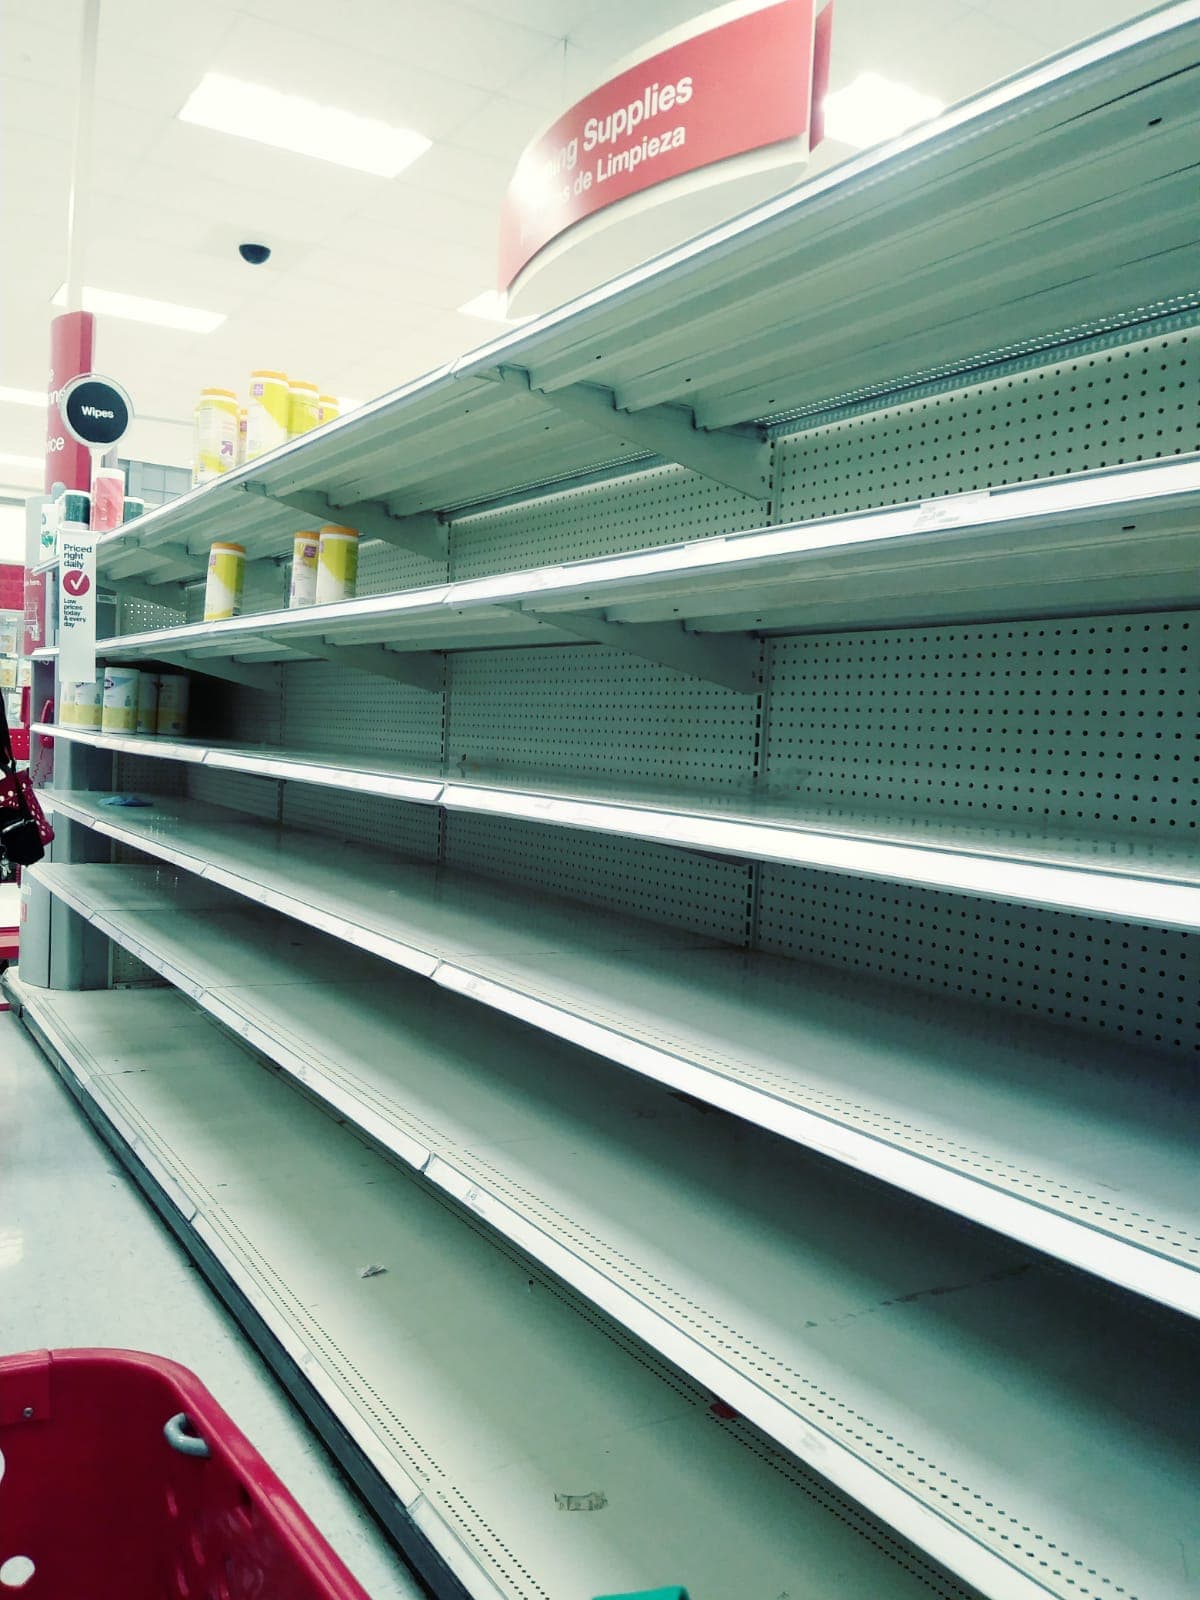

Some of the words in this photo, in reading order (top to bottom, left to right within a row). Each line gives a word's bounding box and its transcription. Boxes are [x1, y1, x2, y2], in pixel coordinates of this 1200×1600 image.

[583, 76, 693, 151] Supplies
[573, 171, 593, 196] de
[597, 126, 686, 183] Limpieza
[81, 405, 114, 419] Wipes
[63, 543, 92, 553] Priced
[63, 552, 84, 561] right
[63, 559, 84, 569] daily
[63, 610, 81, 618] today
[63, 621, 76, 629] day
